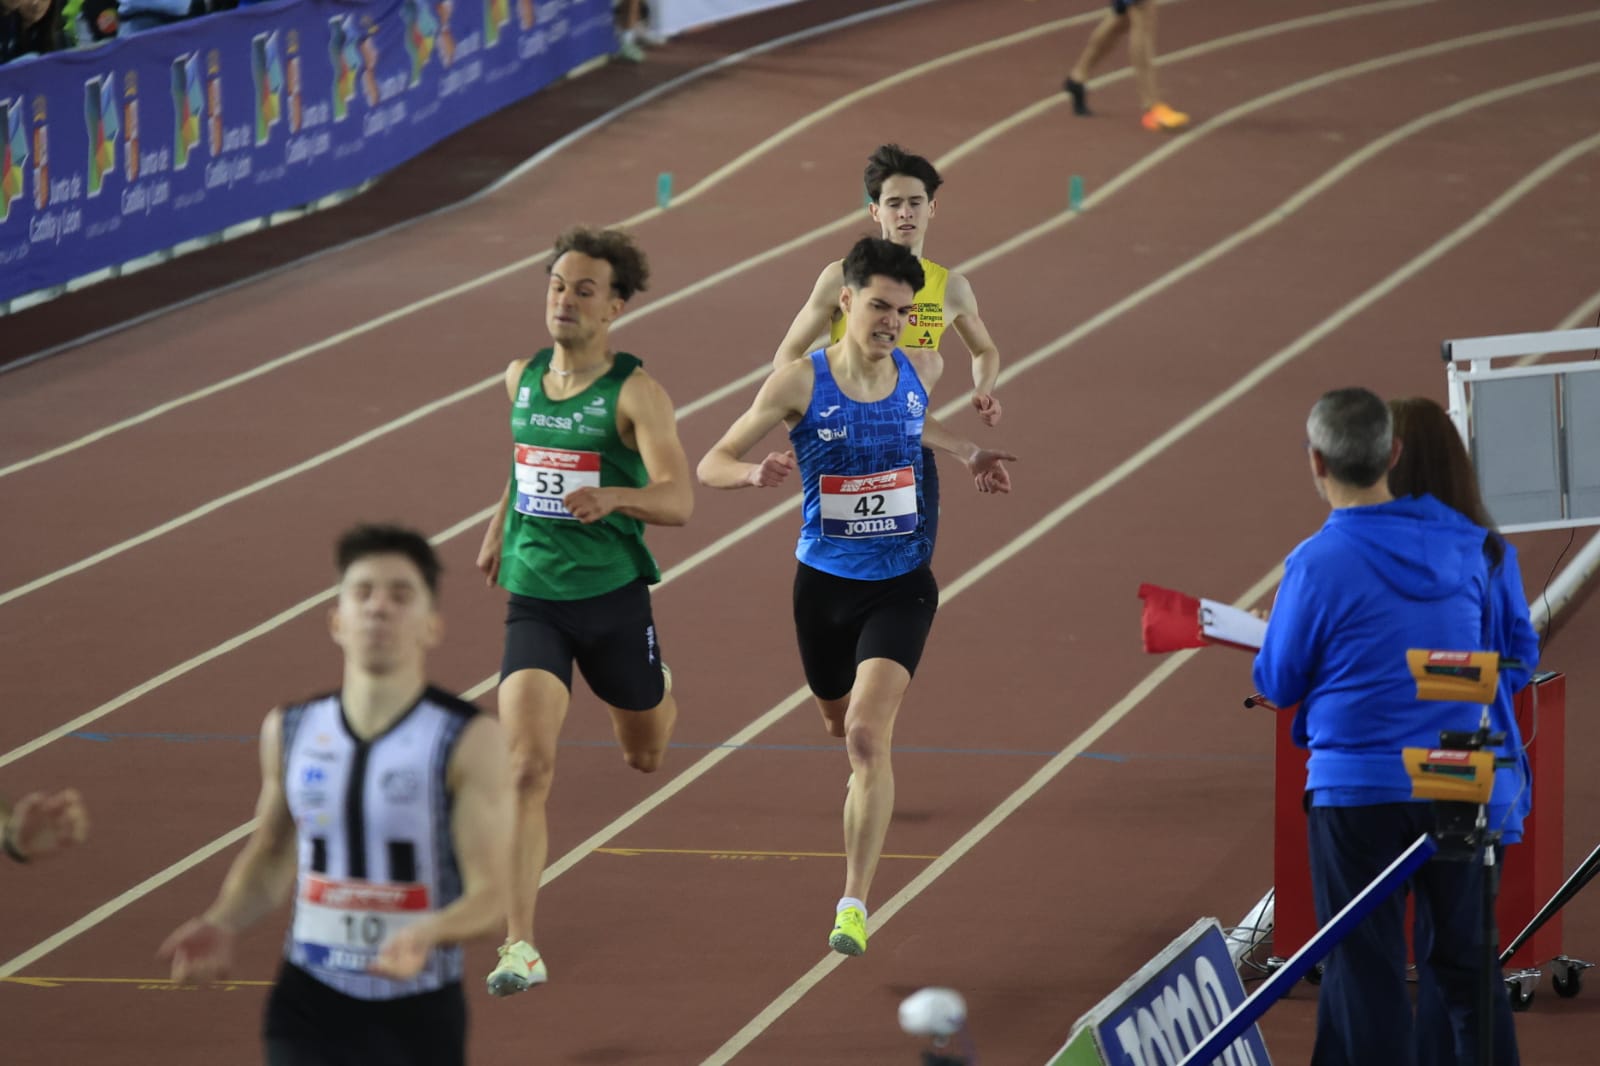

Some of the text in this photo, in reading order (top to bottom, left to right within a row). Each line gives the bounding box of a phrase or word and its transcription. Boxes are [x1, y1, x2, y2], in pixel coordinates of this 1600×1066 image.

[535, 471, 564, 495] 53
[526, 496, 570, 514] Jom
[854, 494, 886, 517] 42
[844, 518, 898, 536] Joma
[341, 914, 385, 944] 10
